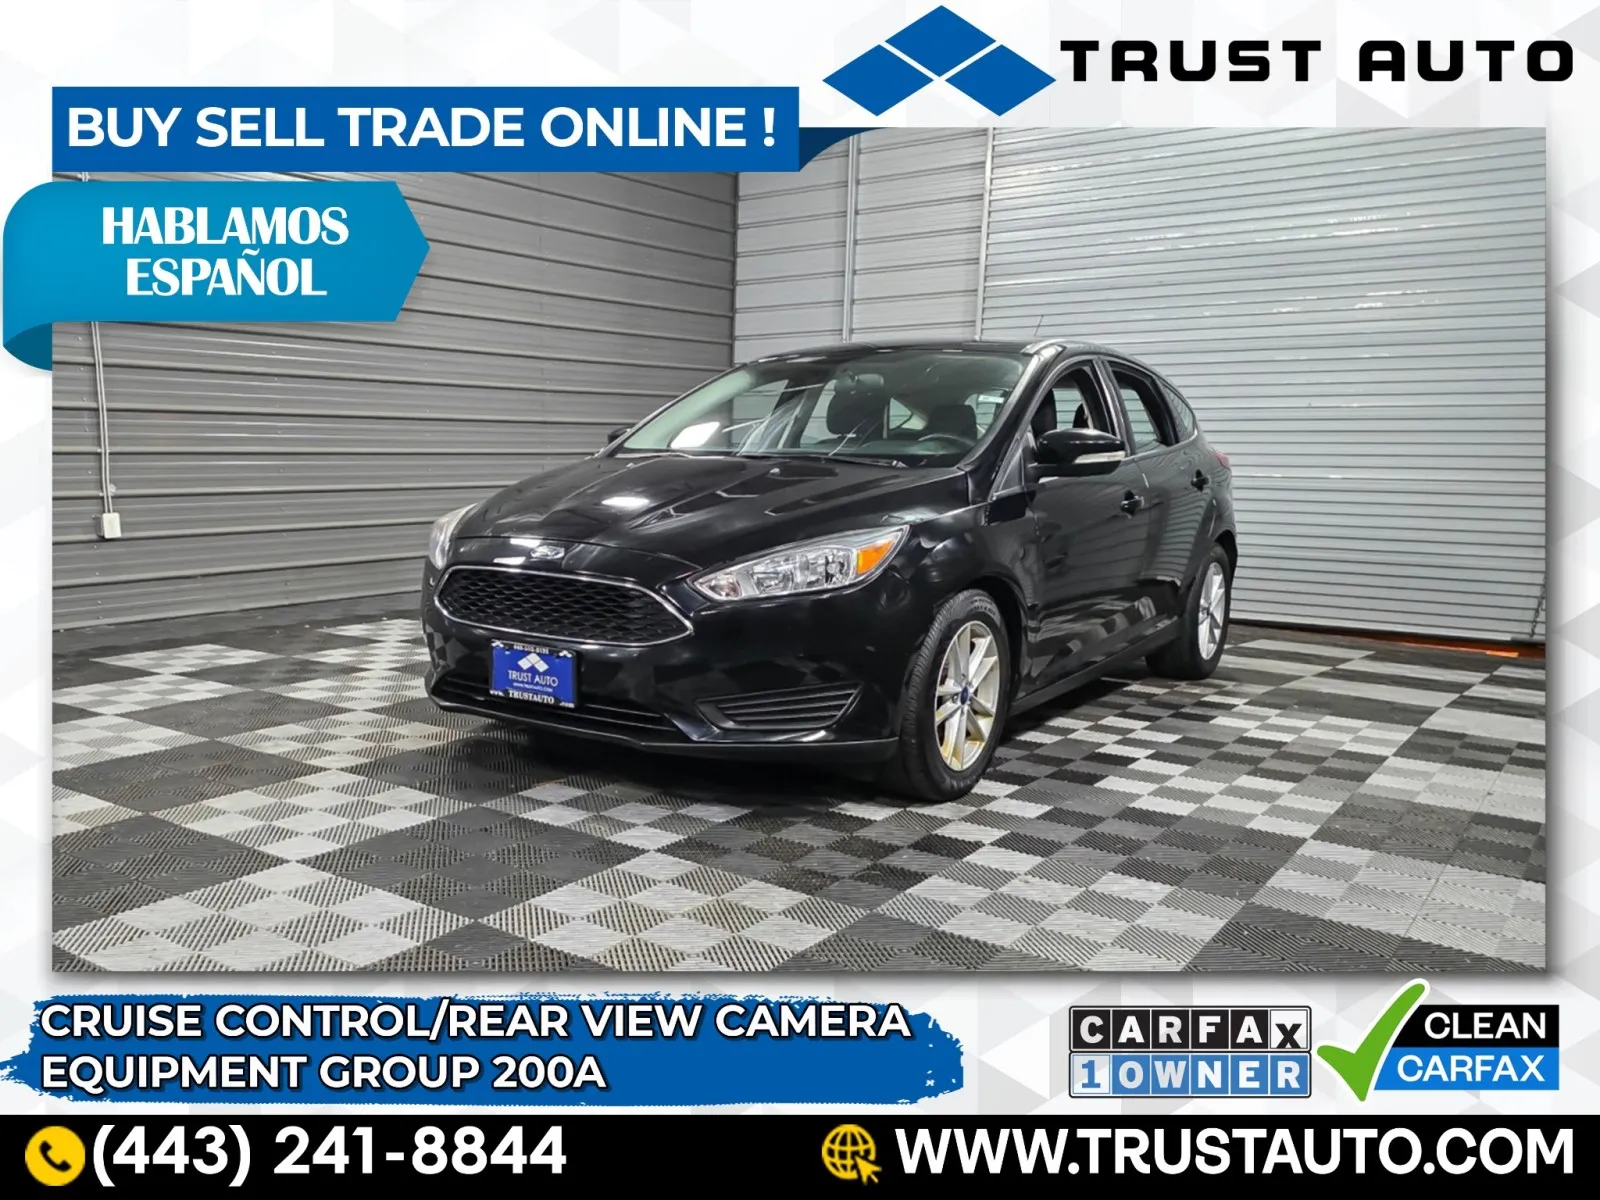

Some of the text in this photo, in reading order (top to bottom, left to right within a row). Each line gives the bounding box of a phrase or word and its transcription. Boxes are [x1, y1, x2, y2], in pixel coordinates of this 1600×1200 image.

[507, 670, 559, 687] TRUST AUTO
[508, 689, 555, 705] TRUSTAUTO
